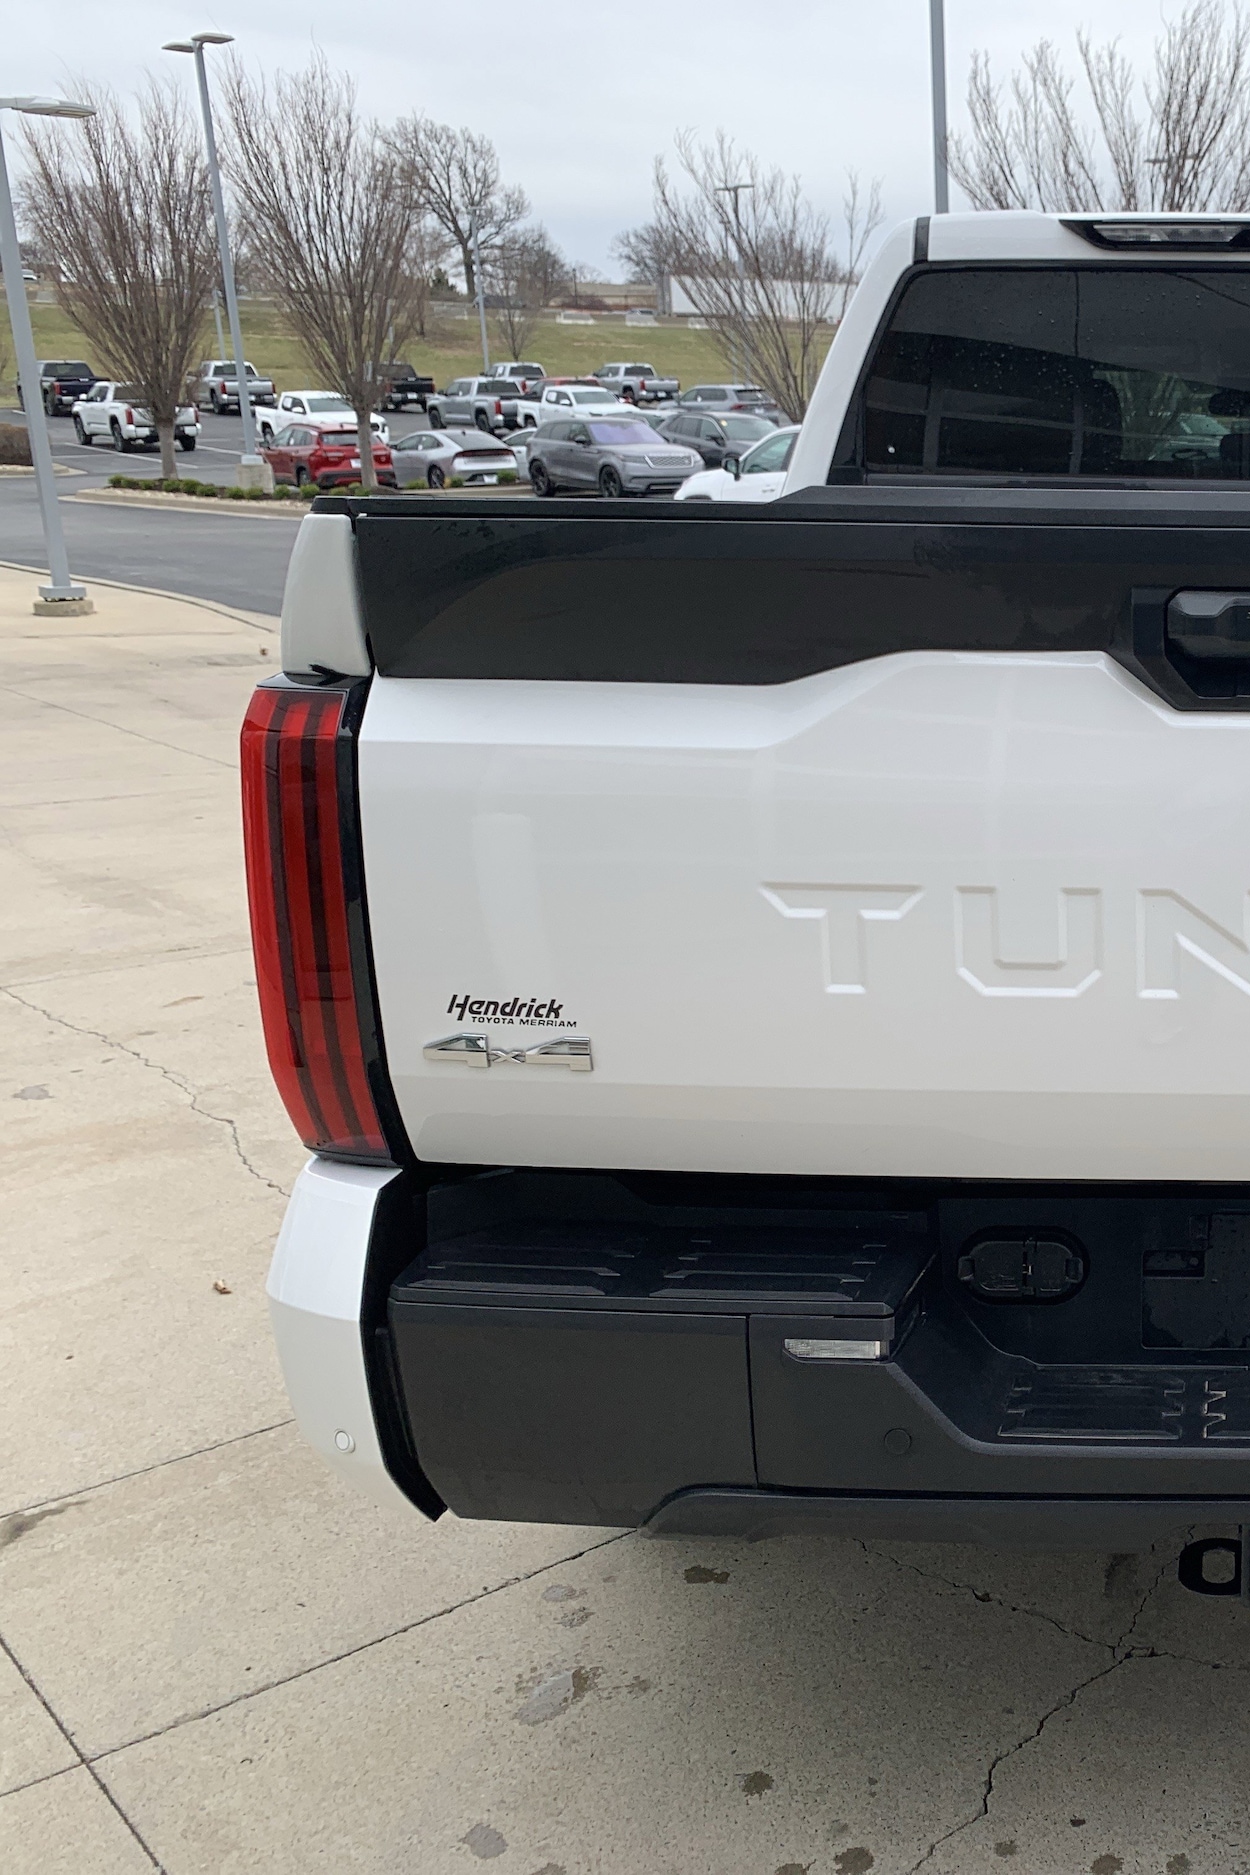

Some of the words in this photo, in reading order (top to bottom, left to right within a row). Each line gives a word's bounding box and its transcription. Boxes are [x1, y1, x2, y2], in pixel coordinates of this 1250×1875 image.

[447, 994, 563, 1021] Hendrick
[472, 1016, 514, 1025] TOYOTA
[519, 1018, 577, 1028] MERRIAM
